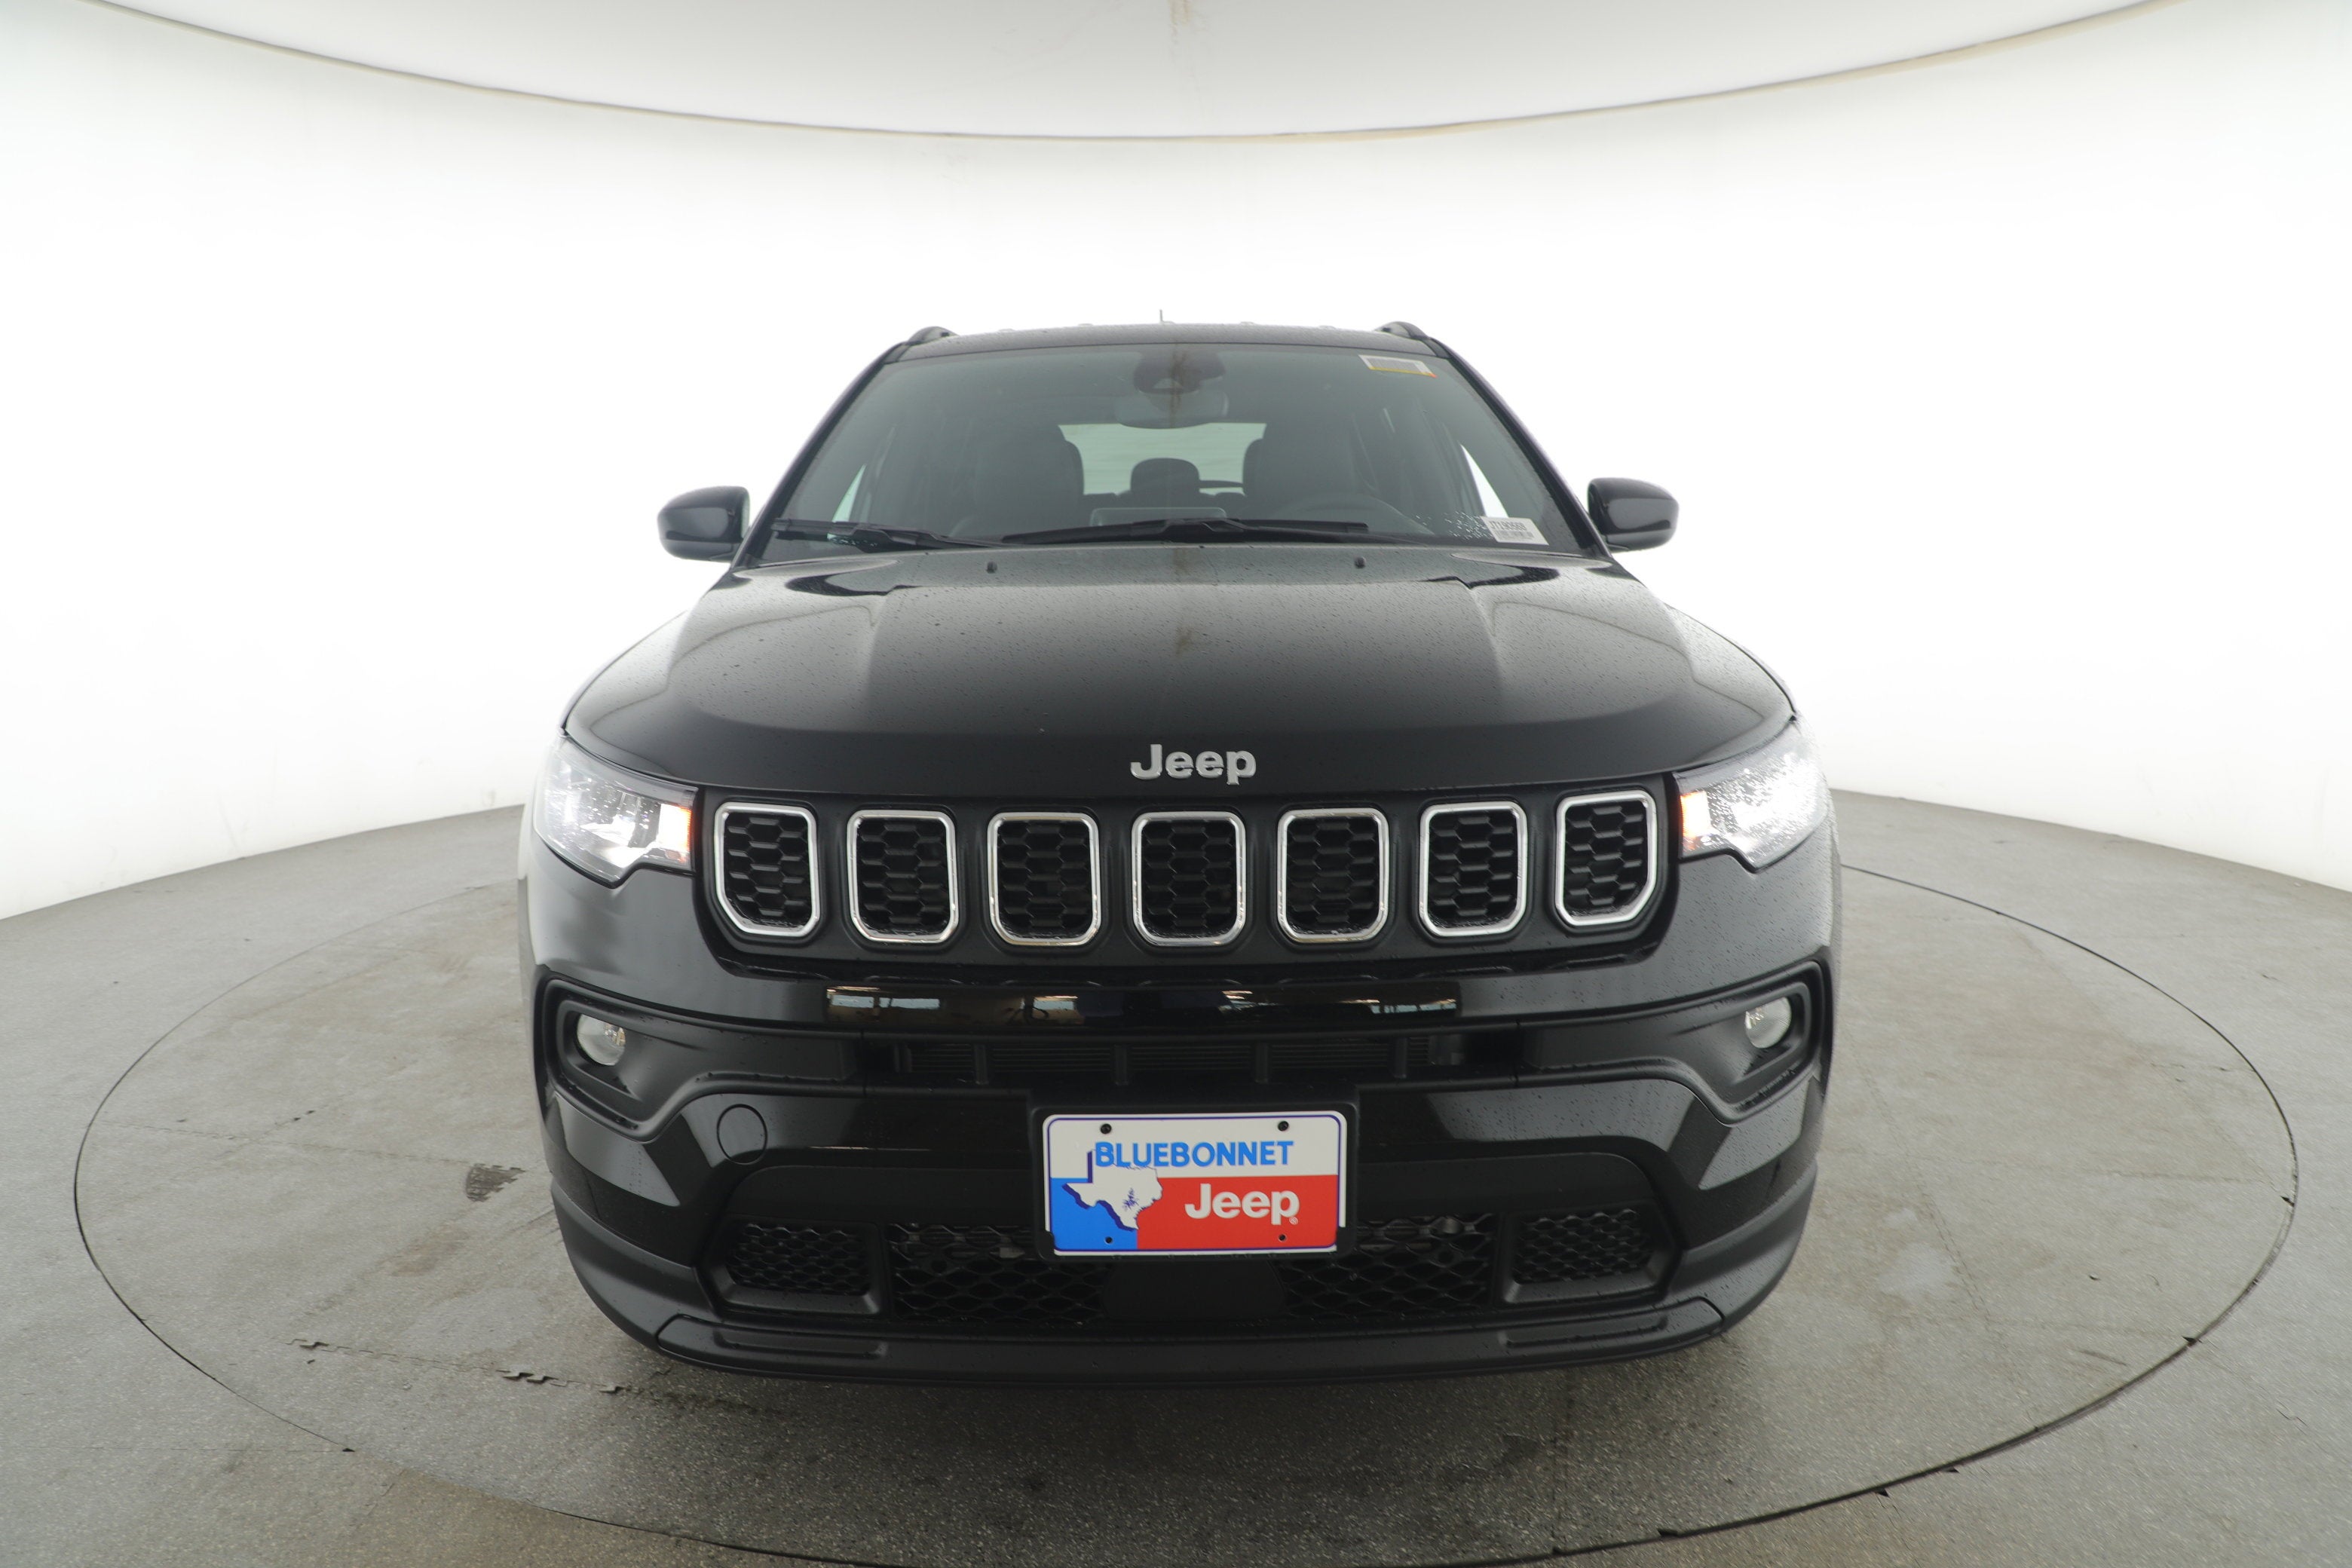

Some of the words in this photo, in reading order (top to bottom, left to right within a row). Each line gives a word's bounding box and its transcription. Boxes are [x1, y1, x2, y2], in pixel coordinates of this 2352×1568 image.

[1130, 743, 1257, 786] Jeep
[1094, 1140, 1294, 1168] BLUEBONNET
[1184, 1183, 1300, 1226] Jeep
